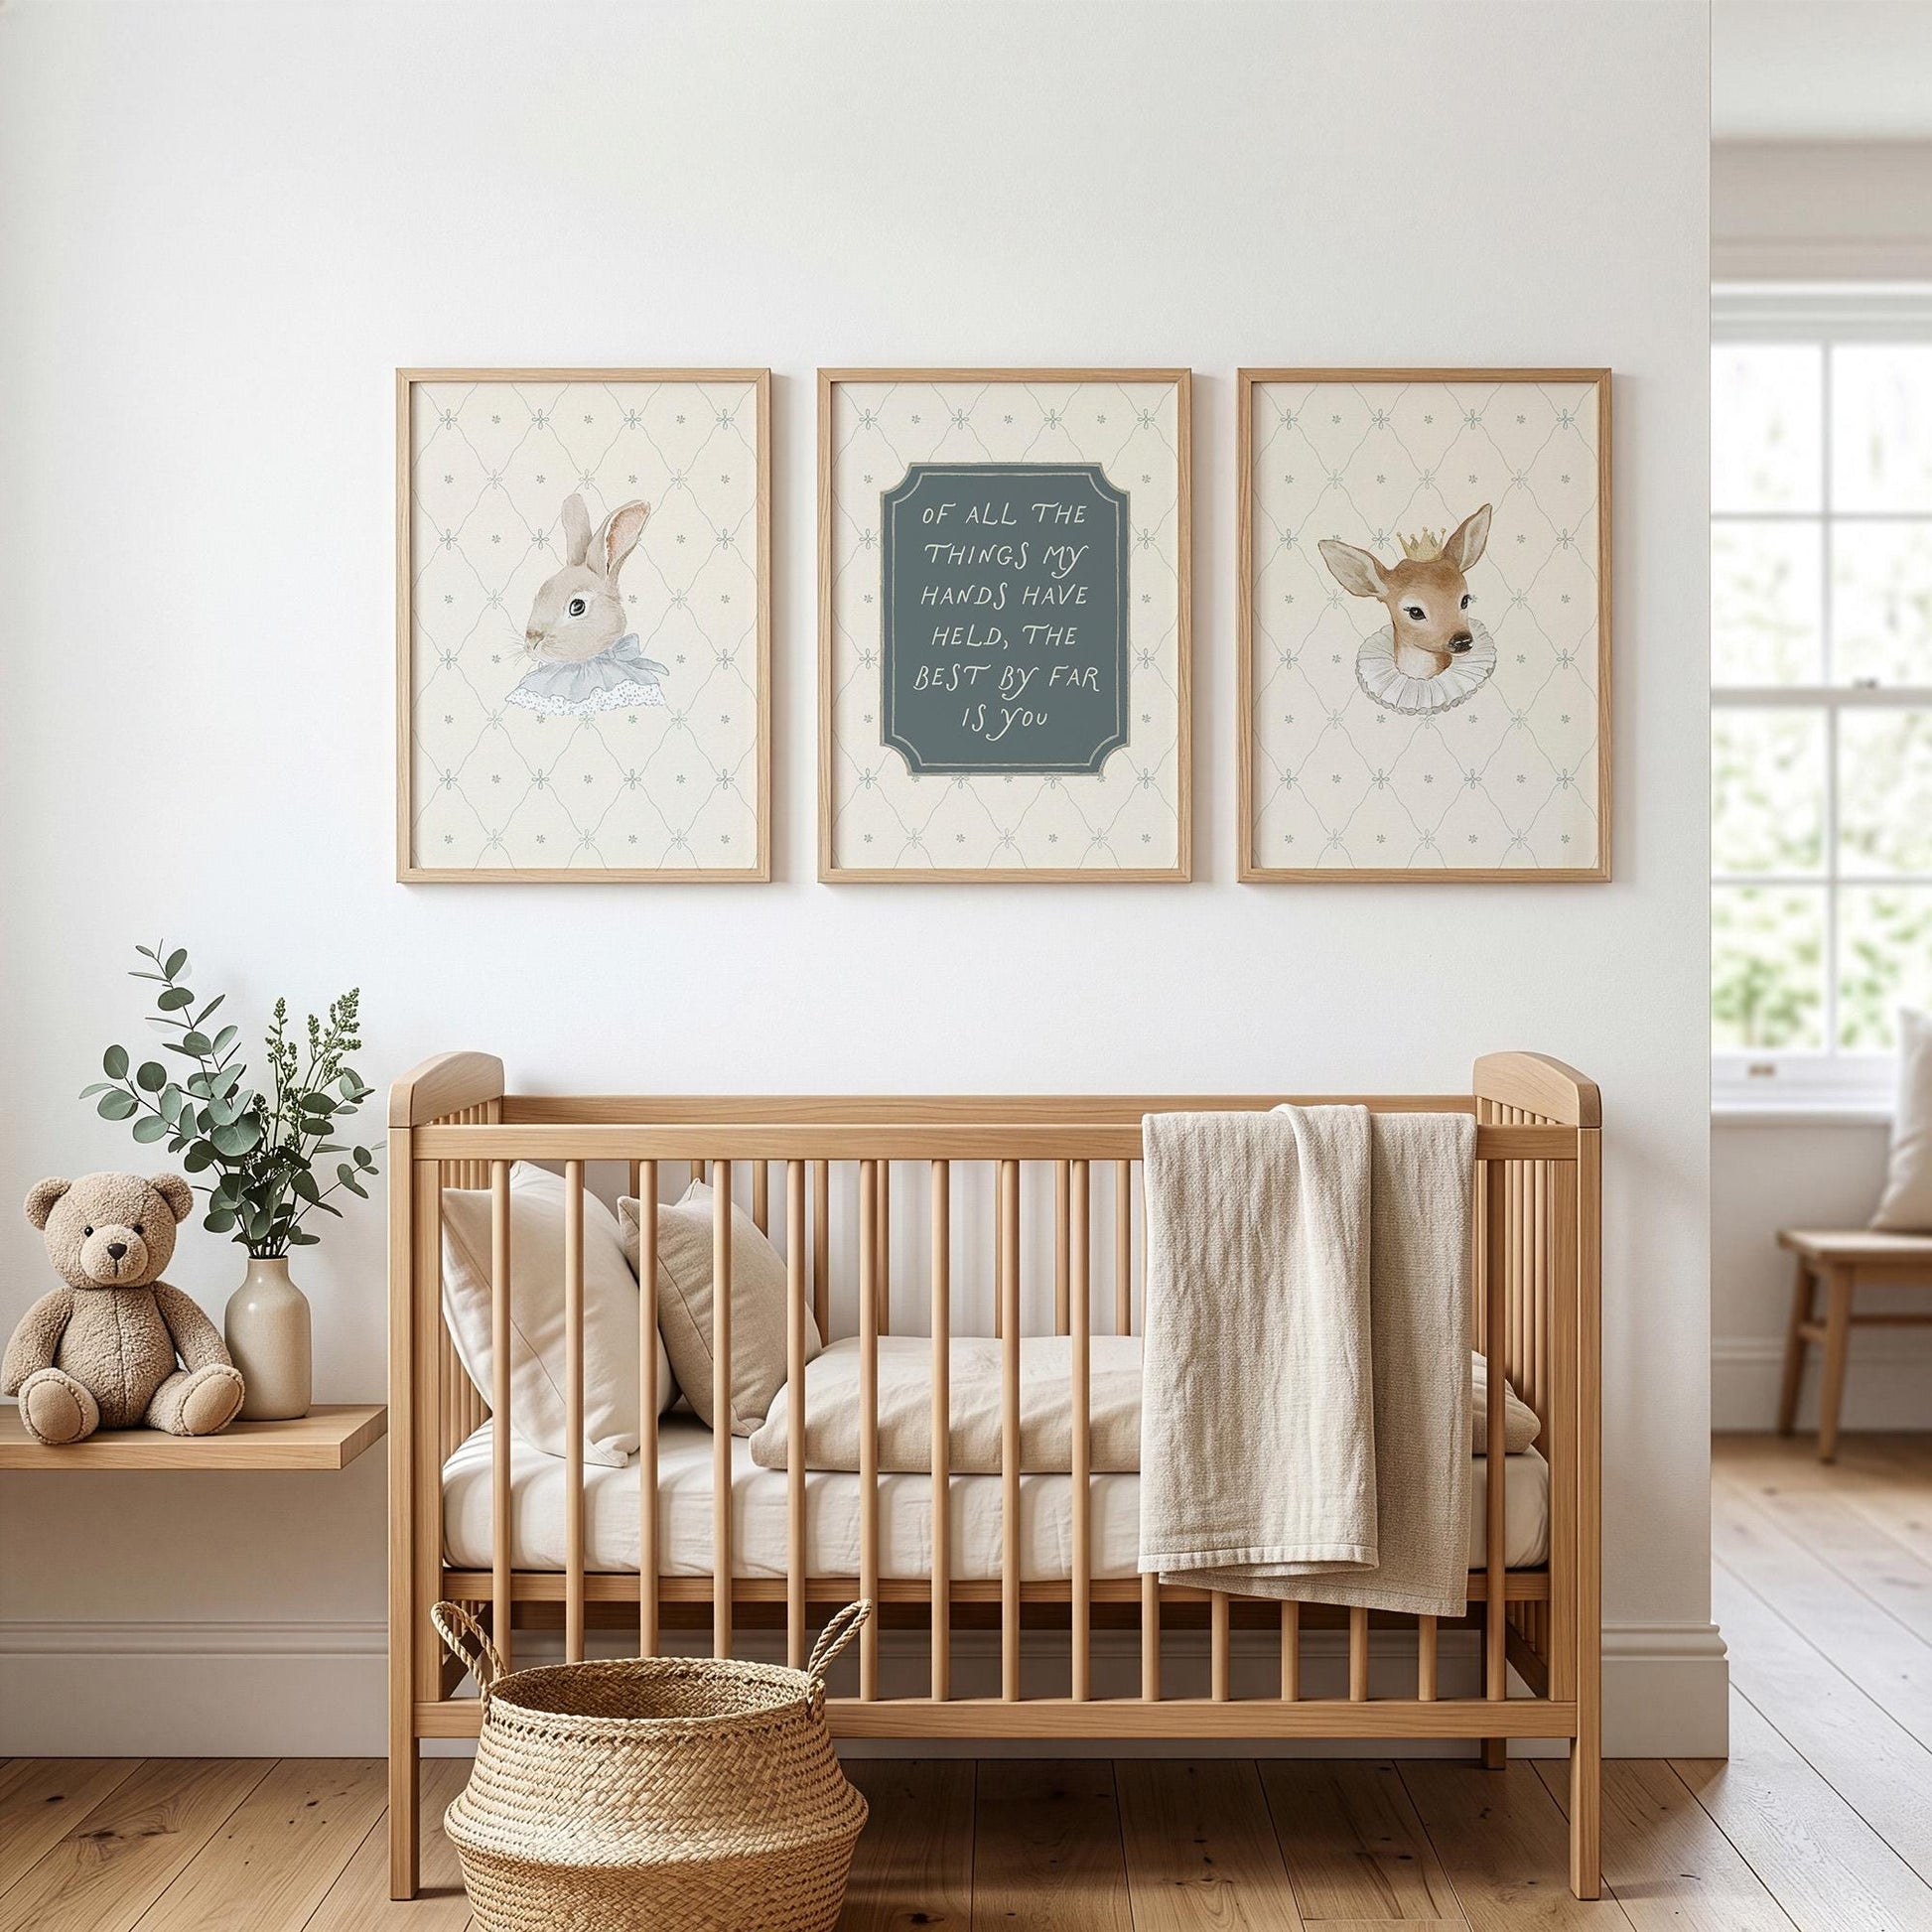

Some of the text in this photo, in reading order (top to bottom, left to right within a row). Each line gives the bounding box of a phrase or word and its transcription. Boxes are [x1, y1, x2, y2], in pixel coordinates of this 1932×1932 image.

[922, 502, 1087, 525] OF ALL THE
[924, 542, 1030, 570] THINGS
[920, 582, 1089, 611] HANDS HAVE
[931, 623, 1078, 650] HELD, THE
[912, 662, 992, 692] BEST
[1048, 664, 1100, 692] FAR
[961, 703, 987, 733] IS
